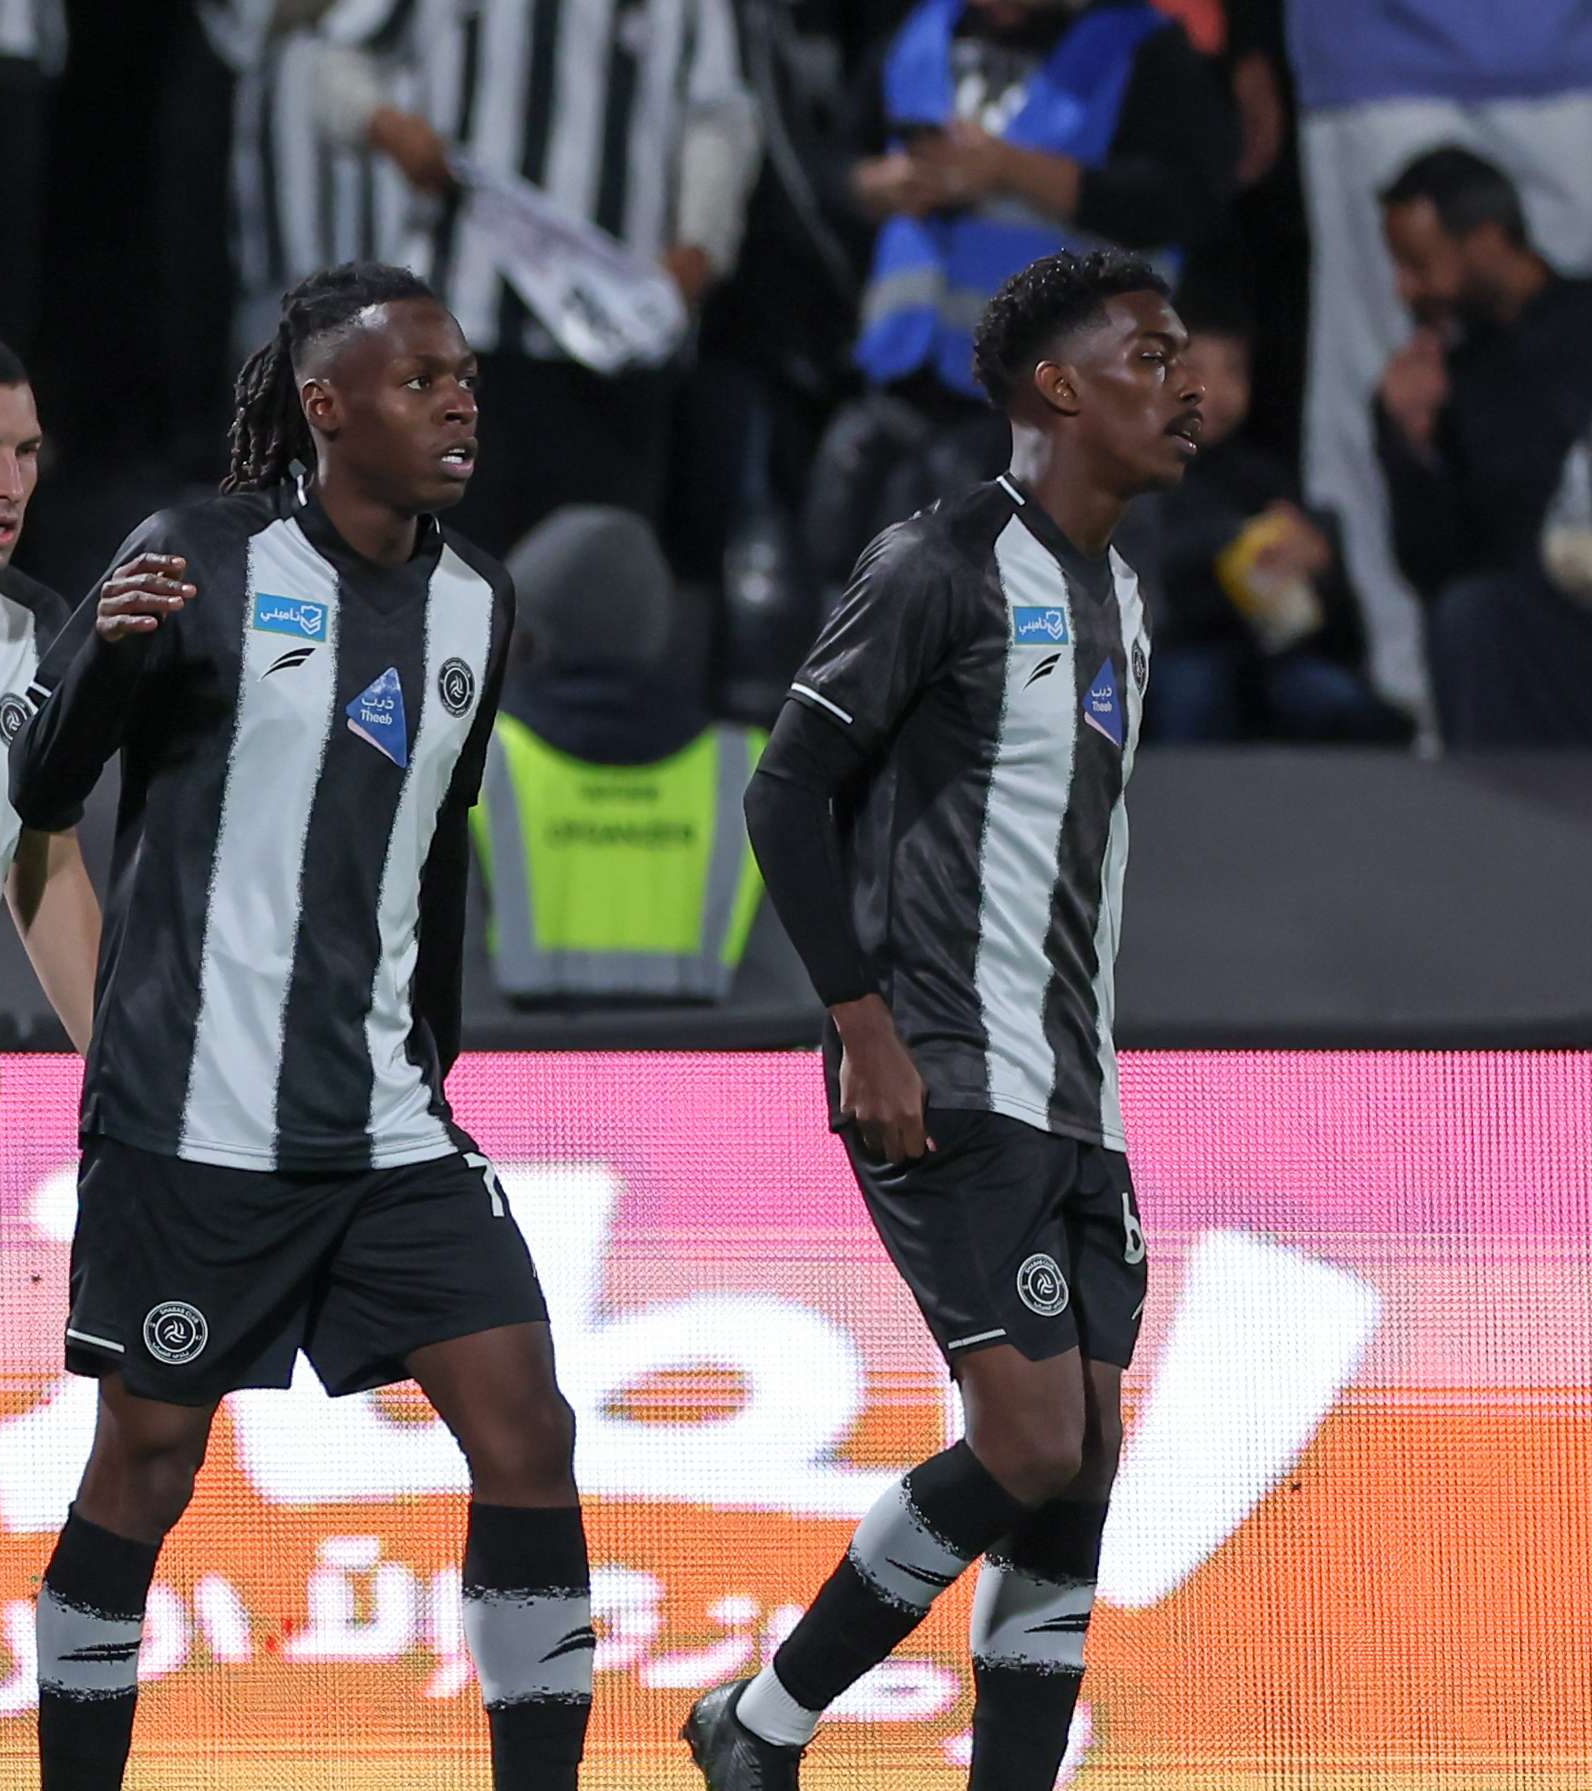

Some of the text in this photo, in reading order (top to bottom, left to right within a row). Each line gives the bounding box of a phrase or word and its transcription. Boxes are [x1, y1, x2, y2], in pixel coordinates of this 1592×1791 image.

[360, 708, 393, 725] Theeb
[462, 1152, 505, 1217] 7
[1122, 1192, 1146, 1264] 6
